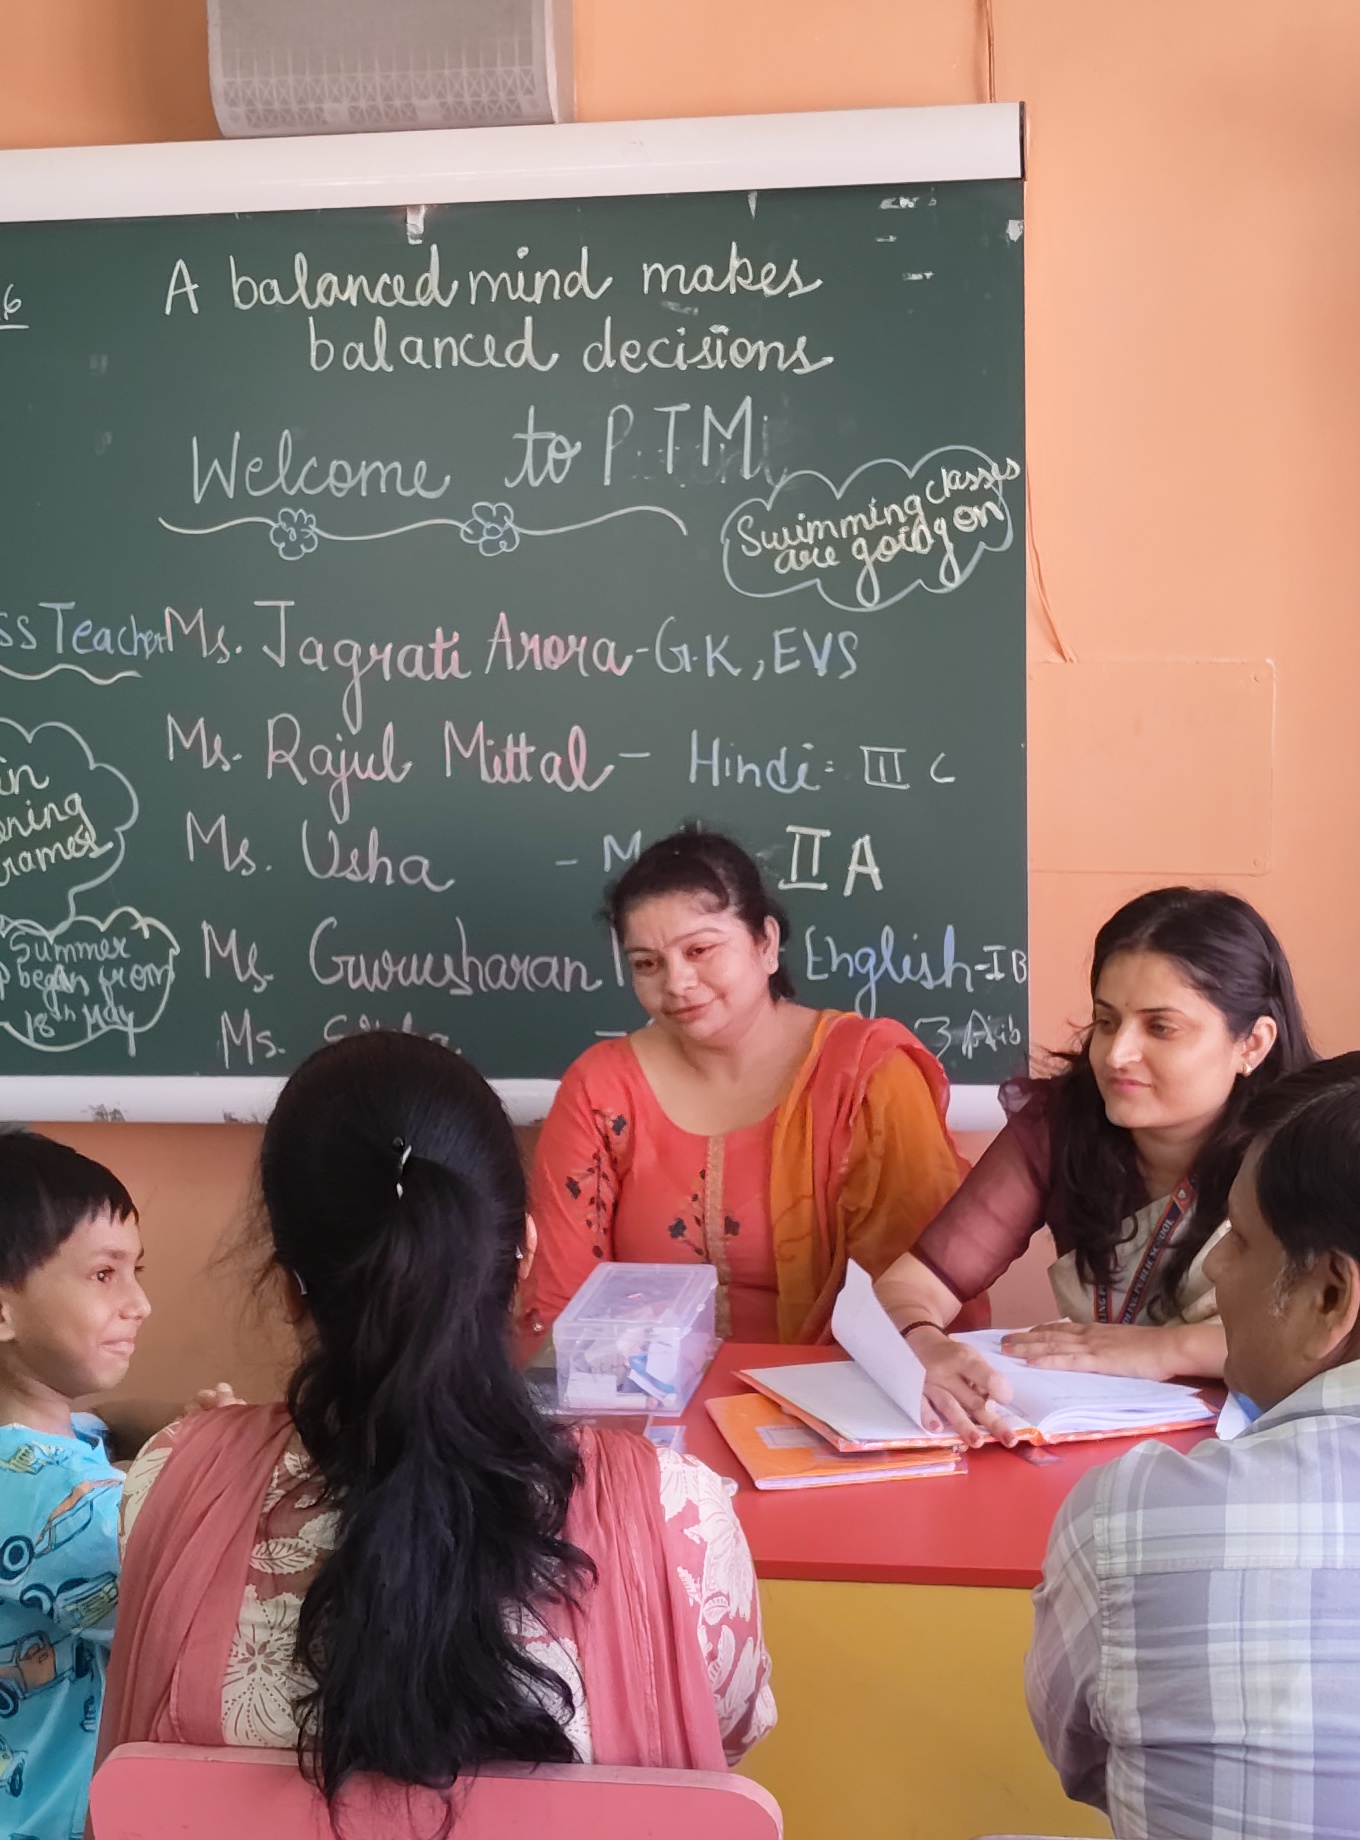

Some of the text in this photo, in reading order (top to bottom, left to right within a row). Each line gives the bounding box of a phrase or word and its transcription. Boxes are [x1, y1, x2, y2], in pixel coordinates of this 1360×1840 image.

[165, 241, 823, 315] A balanced mind makes
[309, 316, 833, 374] balanced decisions
[192, 429, 450, 505] Welcome
[504, 405, 581, 488] to
[737, 457, 1021, 557] Swimming classes
[773, 500, 1005, 608] are going on
[164, 605, 243, 664] Ms.
[254, 600, 472, 735] Jagrati
[166, 713, 242, 772] Ms.
[267, 713, 413, 824] Rajul
[444, 719, 615, 792] Mittal
[186, 810, 273, 876] Ms.
[301, 818, 455, 893] Usha
[9, 930, 131, 963] Summer
[98, 964, 176, 1008] from
[309, 916, 603, 996] Gurusharan
